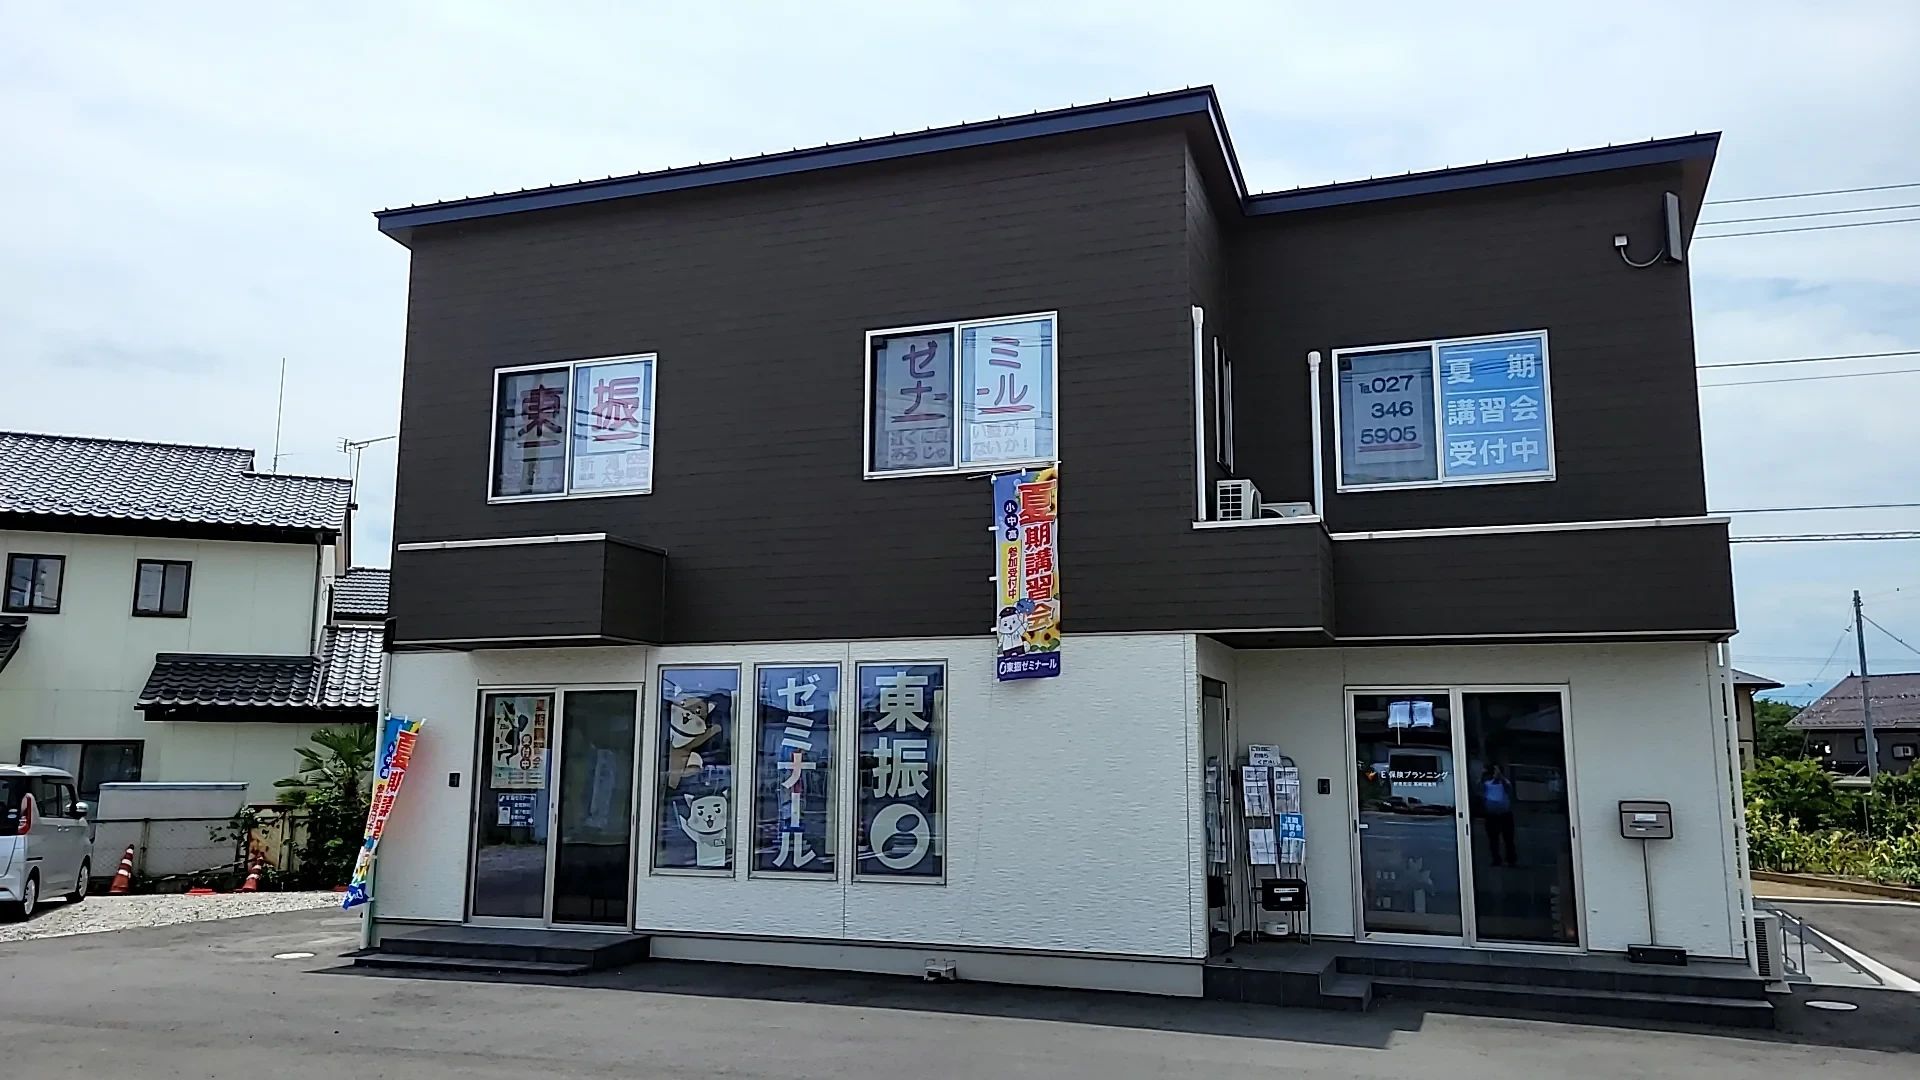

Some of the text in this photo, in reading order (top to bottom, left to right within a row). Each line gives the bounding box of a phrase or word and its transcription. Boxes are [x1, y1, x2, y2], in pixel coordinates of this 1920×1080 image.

[1371, 400, 1414, 419] 346
[1447, 394, 1538, 425] 講習会
[1360, 426, 1417, 445] 5905
[1449, 437, 1539, 467] 受付中
[1018, 479, 1057, 632] 夏期講習会
[873, 671, 930, 799] 東振
[772, 673, 820, 868] ゼミナール
